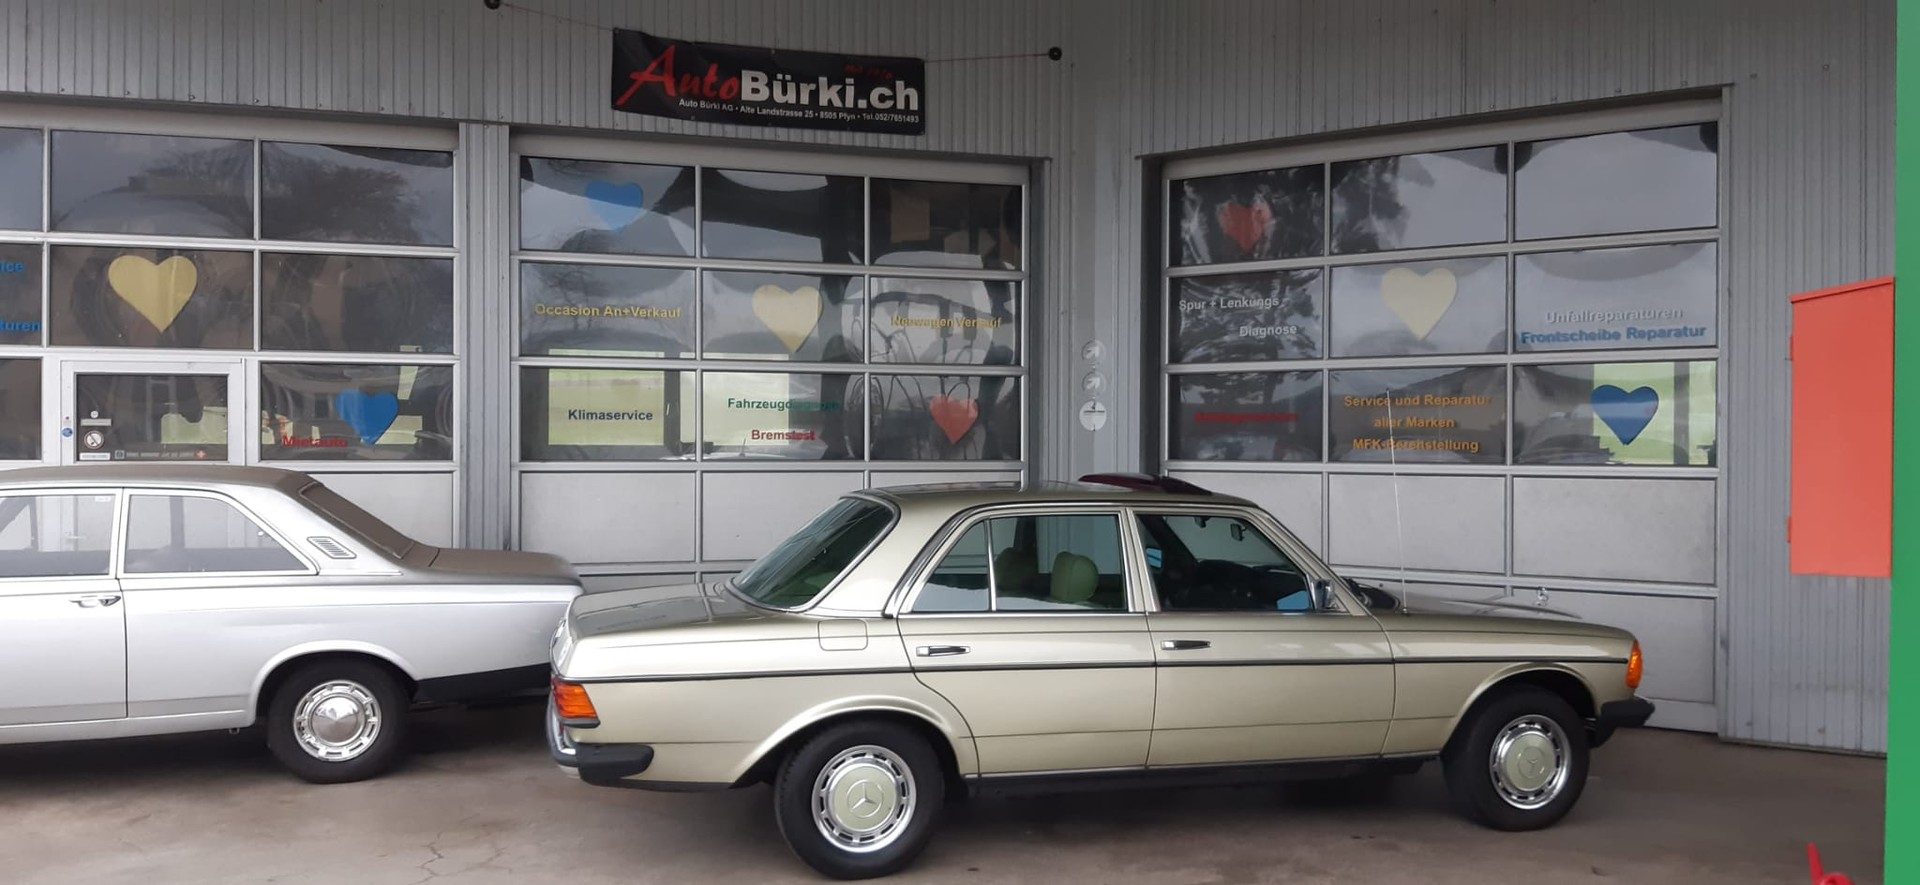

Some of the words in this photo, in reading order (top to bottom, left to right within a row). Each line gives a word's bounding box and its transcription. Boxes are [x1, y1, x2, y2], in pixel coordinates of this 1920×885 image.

[679, 99, 698, 108] Auto
[700, 101, 720, 110] Bürki
[722, 104, 734, 112] AG
[740, 105, 755, 114] Alte
[757, 107, 803, 117] Landstrasse
[804, 110, 814, 118] 25
[820, 111, 837, 119] 8505
[534, 303, 600, 317] Occasion
[603, 305, 682, 319] An+Verkauf
[1179, 300, 1206, 313] Spur
[1547, 307, 1684, 324] Unfallreparaturen
[1240, 325, 1298, 339] Diagnose
[1520, 328, 1621, 344] Frontscheibe
[1626, 325, 1707, 341] Reparatur
[727, 397, 841, 412] Fahrzeugd
[1344, 395, 1391, 407] Service
[1395, 395, 1420, 407] und
[568, 408, 653, 421] Klimaservice
[1406, 416, 1456, 428] Marken
[751, 429, 816, 441] Bremstest
